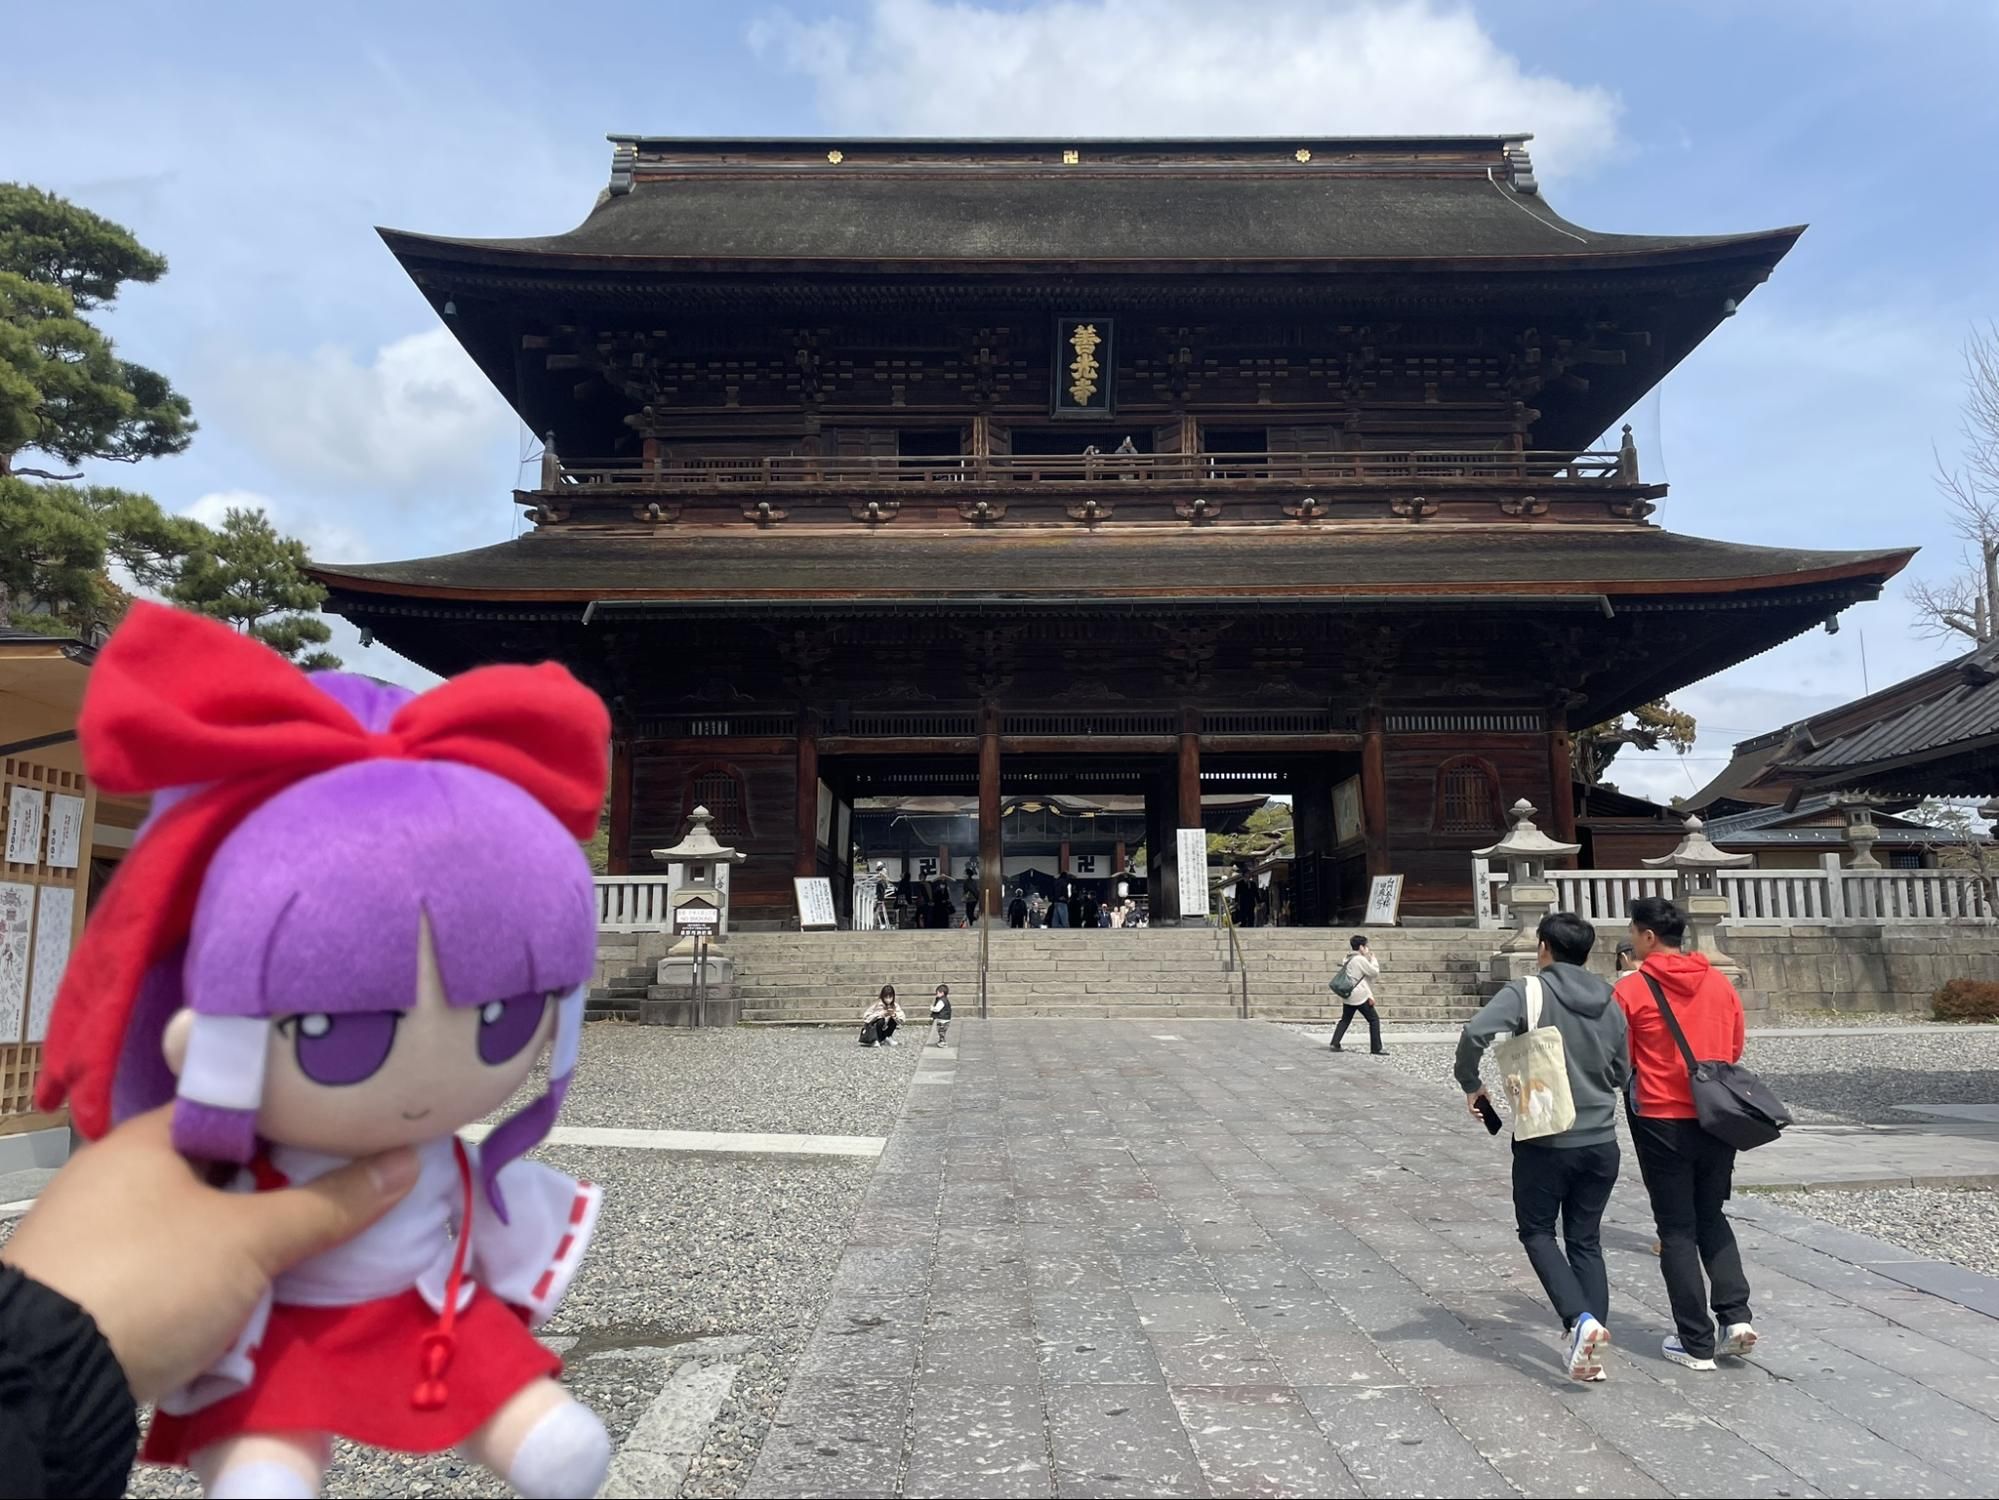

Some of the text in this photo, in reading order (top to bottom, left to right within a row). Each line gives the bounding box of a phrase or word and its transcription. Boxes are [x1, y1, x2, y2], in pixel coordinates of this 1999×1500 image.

[1068, 323, 1102, 407] 善光寺
[1478, 871, 1490, 918] 善光寺
